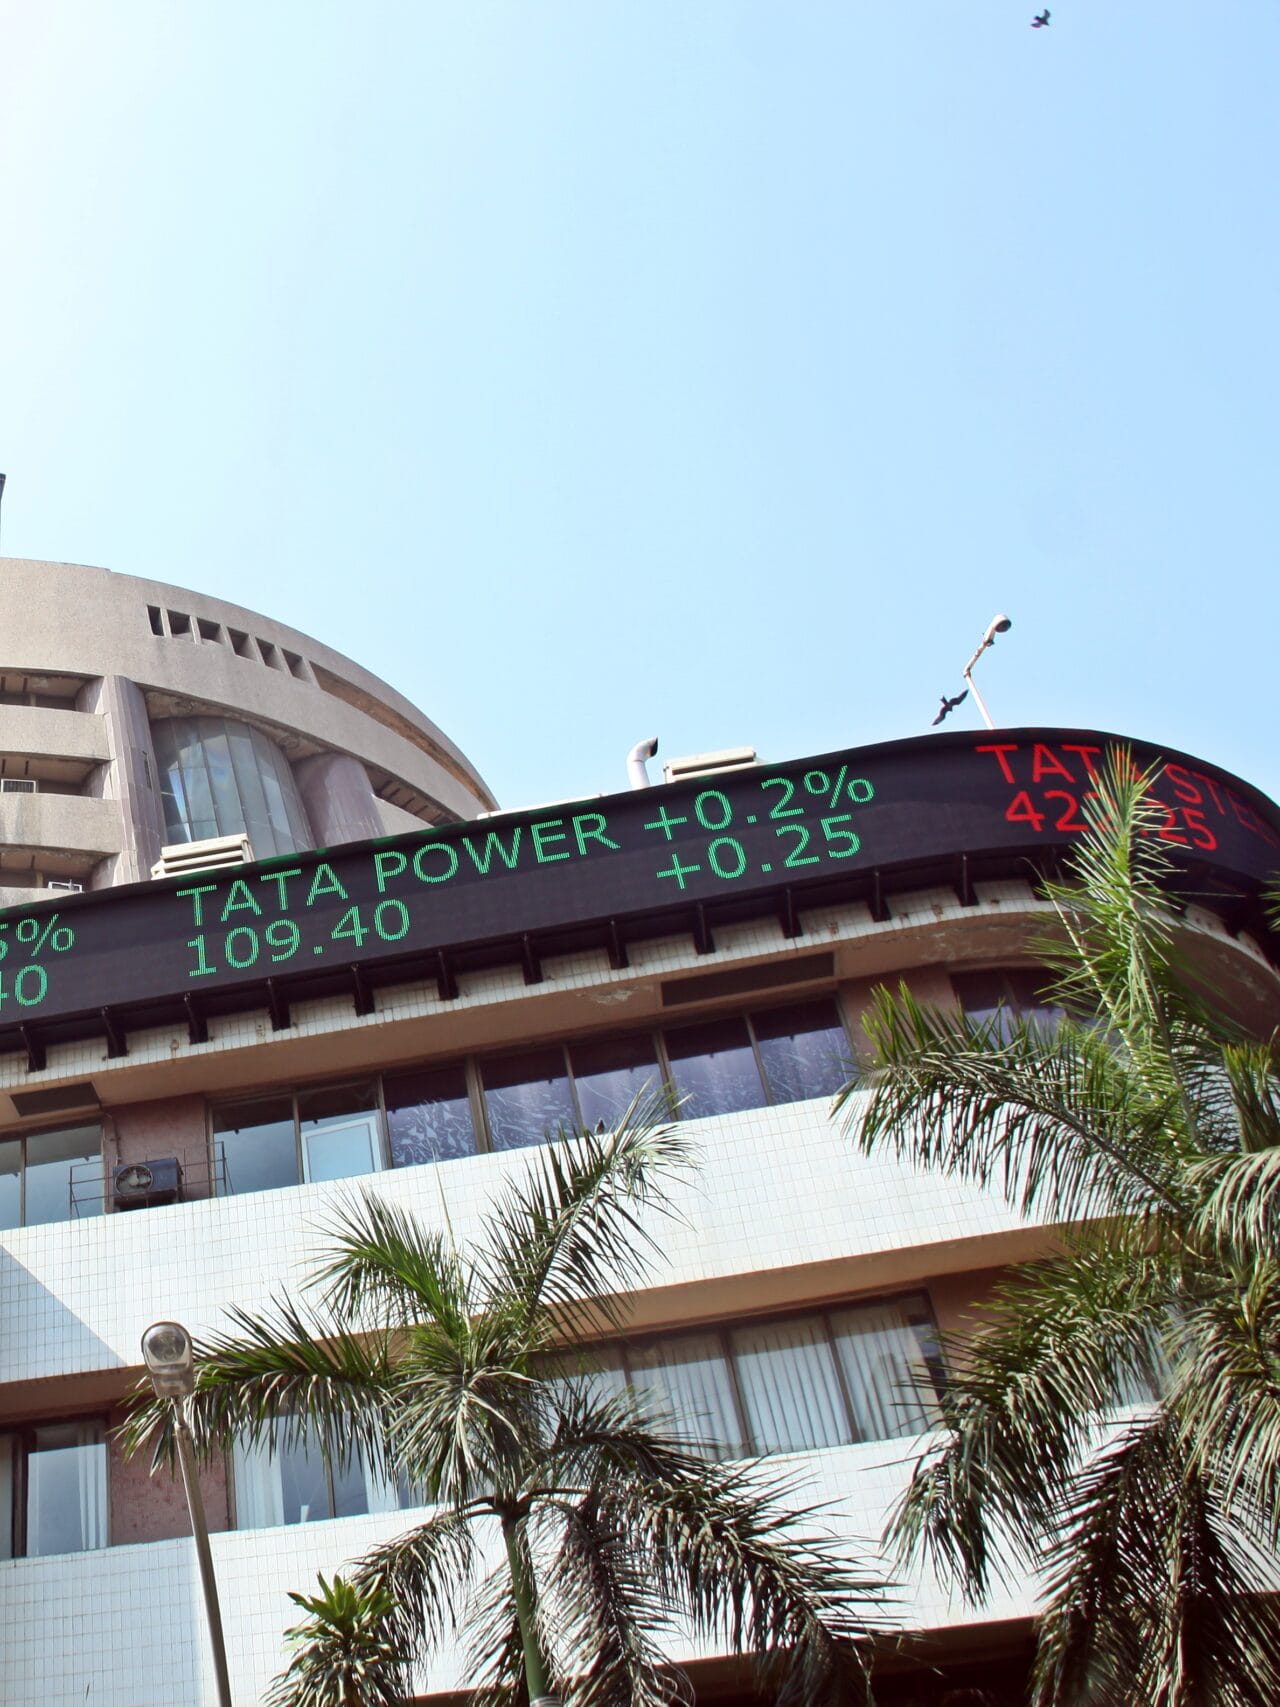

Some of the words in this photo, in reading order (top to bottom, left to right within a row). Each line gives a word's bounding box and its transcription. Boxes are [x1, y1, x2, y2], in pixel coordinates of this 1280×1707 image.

[176, 863, 349, 926] TATA
[374, 813, 621, 892] POWER
[644, 764, 876, 841] +0.2%
[186, 899, 410, 978] 109.40
[656, 813, 861, 890] +0.25
